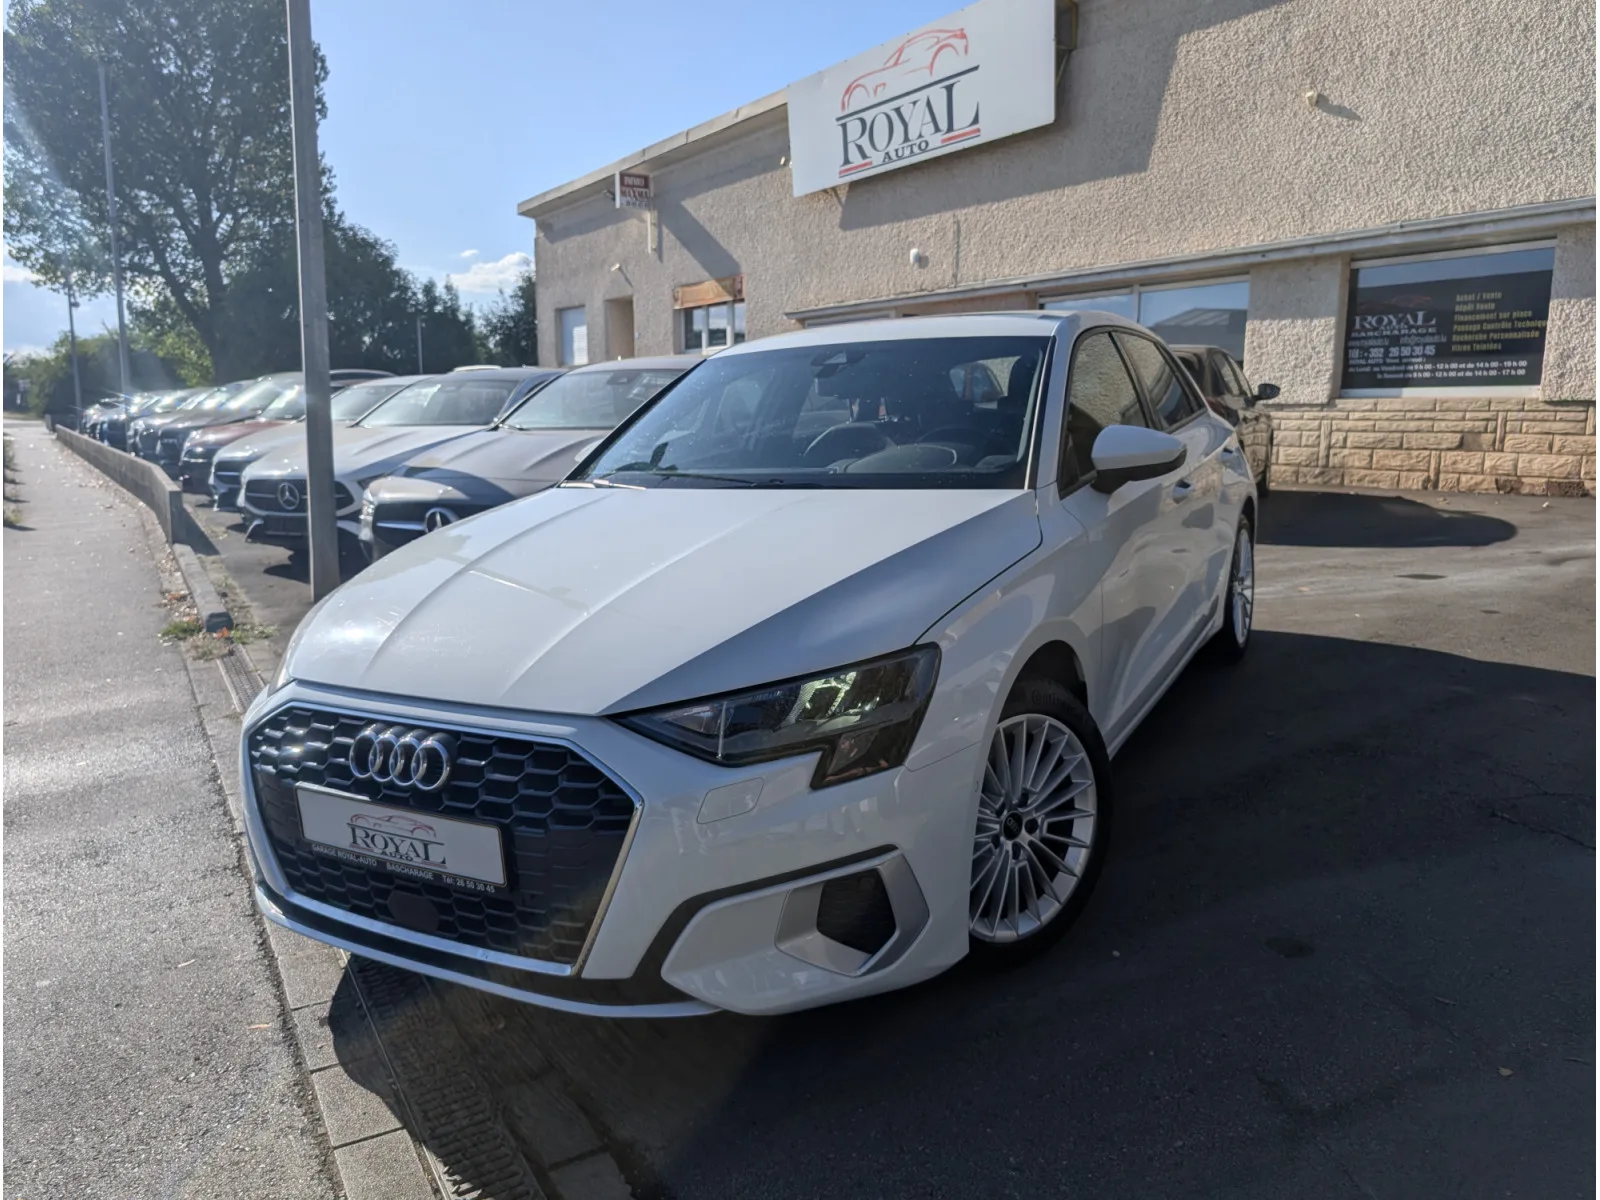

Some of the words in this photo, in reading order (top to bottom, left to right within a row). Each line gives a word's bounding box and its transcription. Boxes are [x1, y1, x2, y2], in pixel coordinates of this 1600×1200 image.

[837, 80, 979, 167] ROYAL
[882, 140, 930, 163] AUTO
[1354, 310, 1436, 329] ROYAL
[1514, 320, 1547, 329] Techniqu
[1351, 327, 1437, 337] BASCHARAGE
[1389, 347, 1400, 357] 26
[1400, 346, 1411, 356] 50
[1412, 346, 1423, 356] 30
[1424, 345, 1435, 355] 45
[350, 826, 446, 865] ROYAL
[380, 850, 414, 862] AUTO
[312, 844, 336, 857] GARAGE
[337, 850, 377, 867] ROYAL-AUTO
[386, 862, 434, 880] BASCHARAGE
[456, 878, 464, 887] 26
[466, 880, 475, 889] 50
[476, 882, 485, 891] 30
[486, 884, 495, 894] 45
